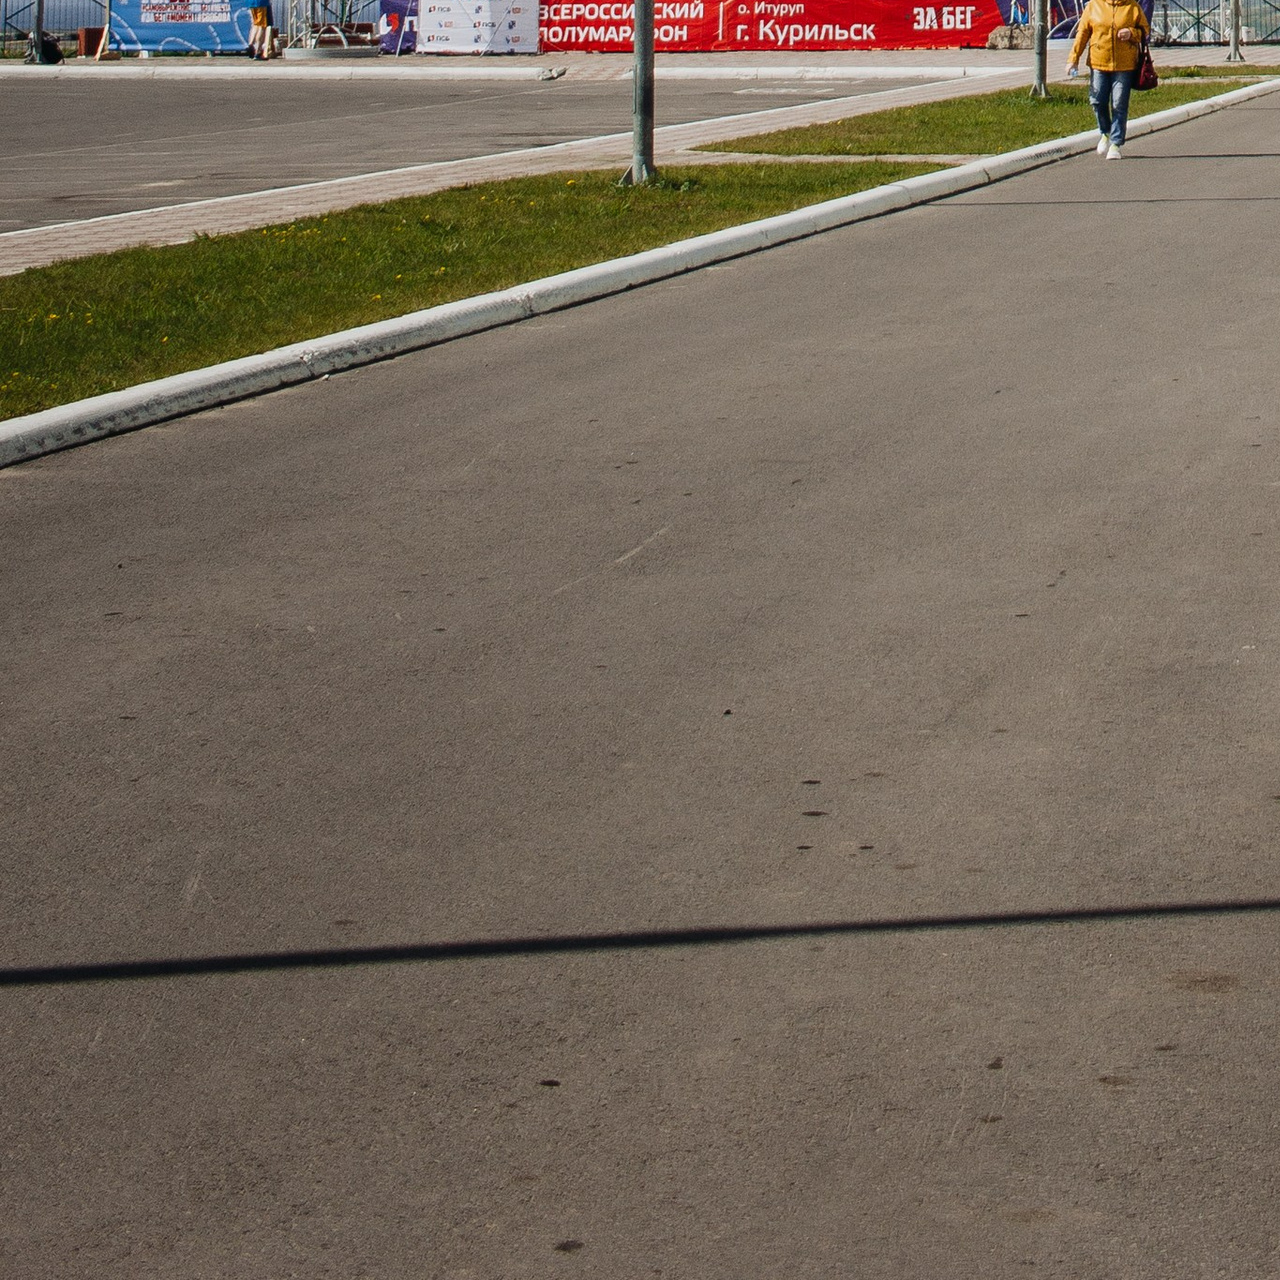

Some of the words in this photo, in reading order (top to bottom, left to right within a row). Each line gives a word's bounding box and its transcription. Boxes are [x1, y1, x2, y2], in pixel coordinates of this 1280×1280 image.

[539, 0, 704, 20] ВСЕРОССИСКИЙ
[738, 3, 751, 15] о.
[754, 1, 805, 17] Итуруп
[913, 6, 939, 30] ЗА
[942, 6, 976, 30] БЕГ
[736, 24, 749, 41] г.
[759, 19, 876, 46] Курильск
